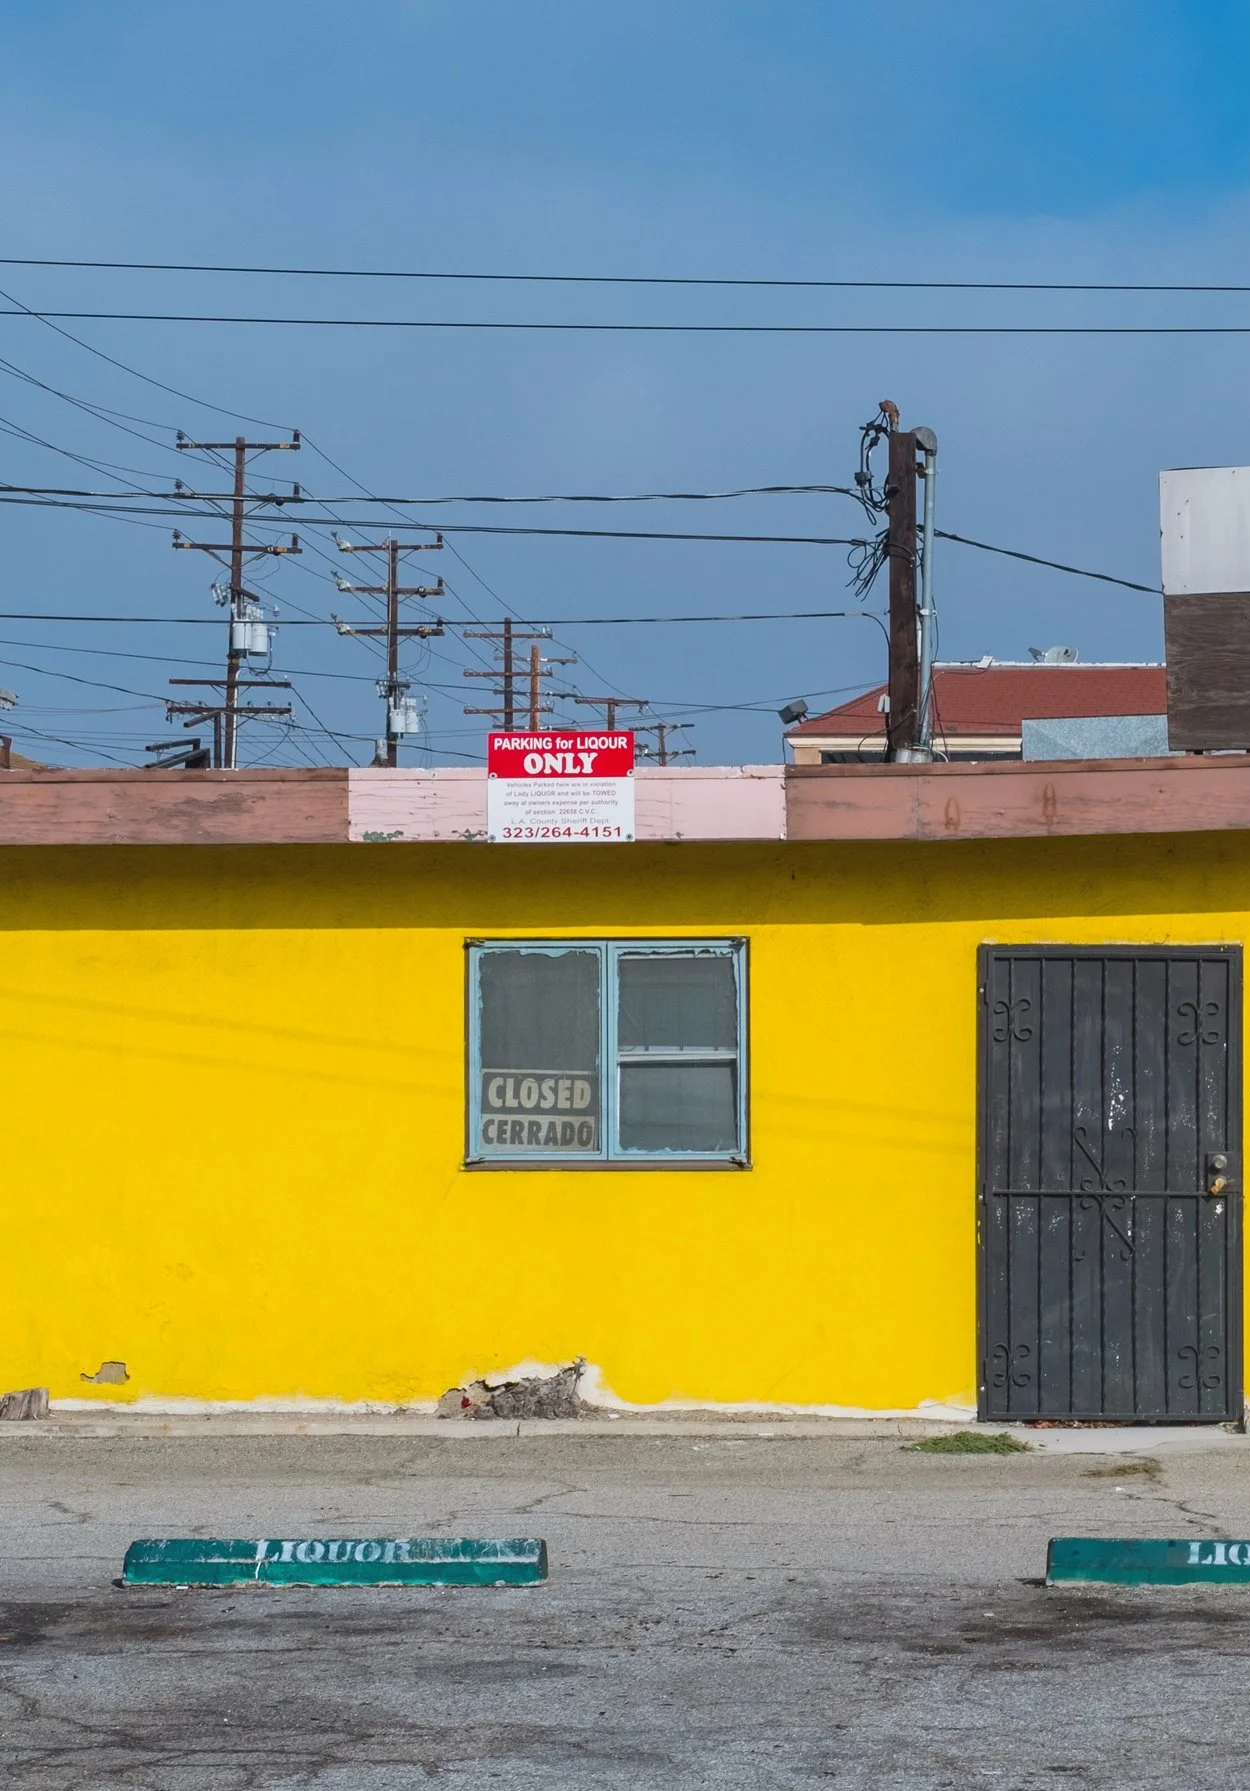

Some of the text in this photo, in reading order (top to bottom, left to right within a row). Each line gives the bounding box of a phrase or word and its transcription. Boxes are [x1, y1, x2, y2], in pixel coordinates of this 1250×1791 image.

[494, 736, 628, 750] PARKING for LIQOUR
[523, 752, 598, 774] ONLY
[503, 826, 621, 838] 323/264-4151
[488, 1077, 591, 1109] CLOSED
[482, 1119, 593, 1147] CERRADO
[255, 1538, 411, 1563] LIQUOR
